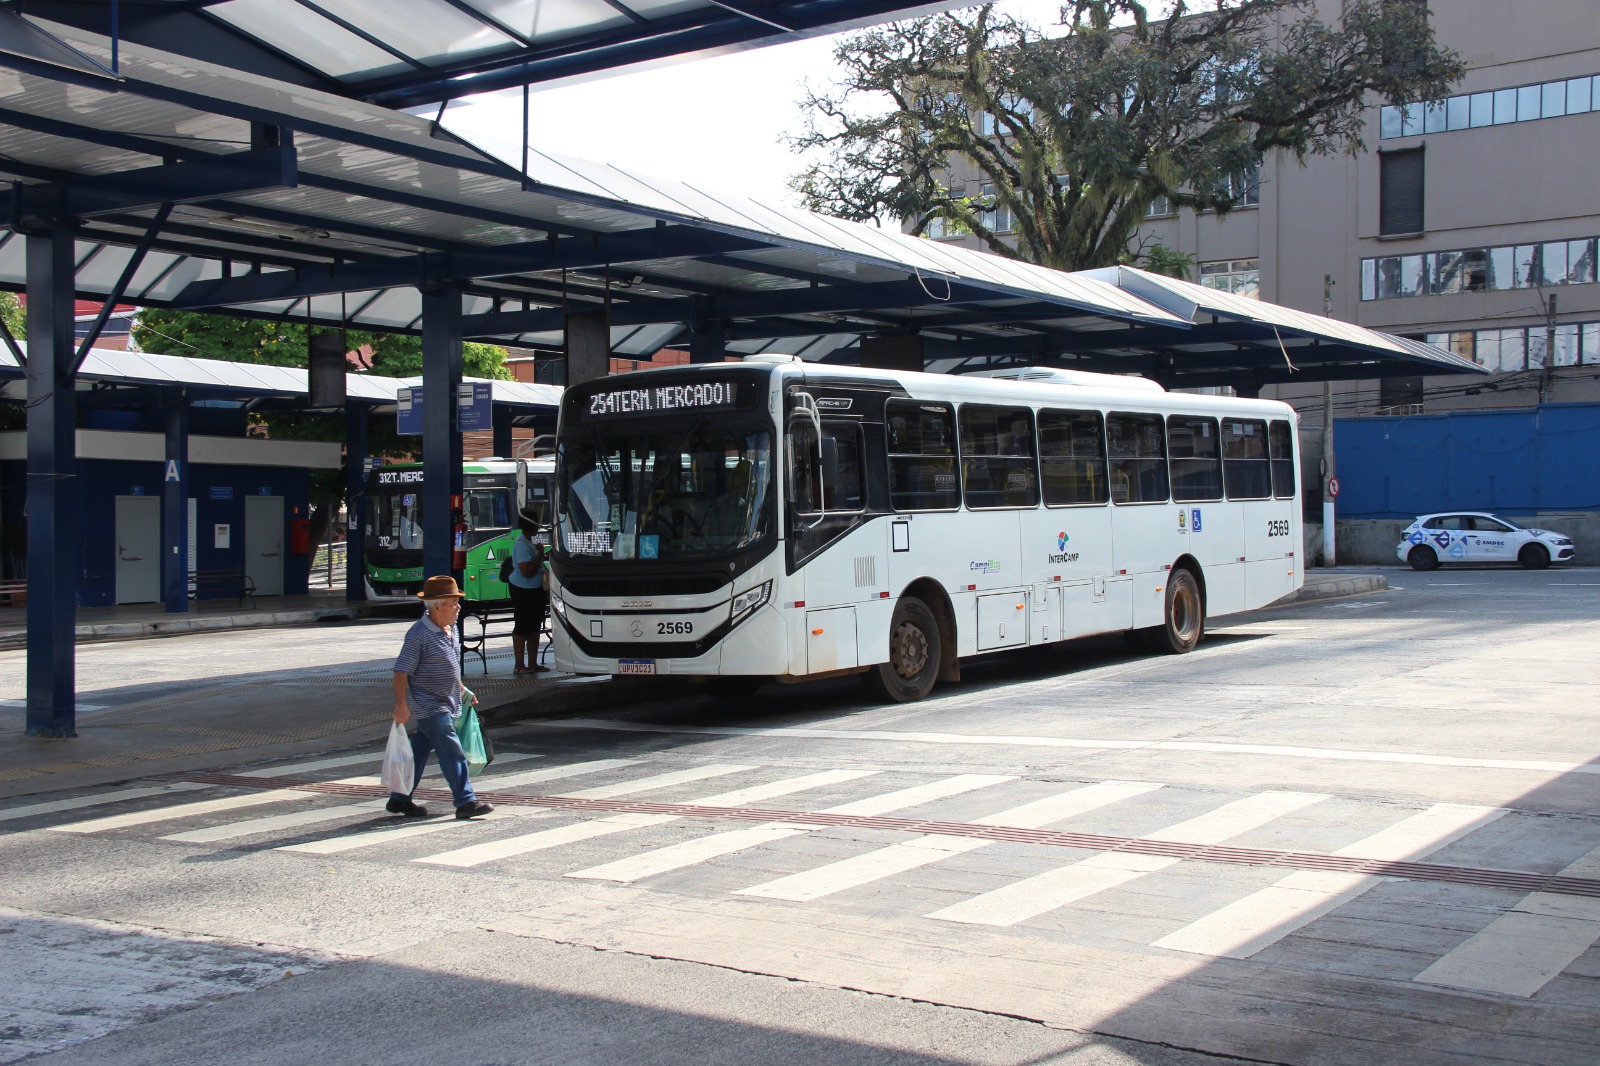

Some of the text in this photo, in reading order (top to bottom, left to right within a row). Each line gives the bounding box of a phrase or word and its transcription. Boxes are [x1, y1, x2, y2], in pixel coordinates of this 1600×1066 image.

[656, 383, 723, 409] MERCADO
[165, 460, 180, 481] A
[1267, 520, 1289, 537] 2569
[379, 536, 391, 547] 312
[657, 621, 693, 635] 2569
[622, 664, 652, 674] UPV1C21
